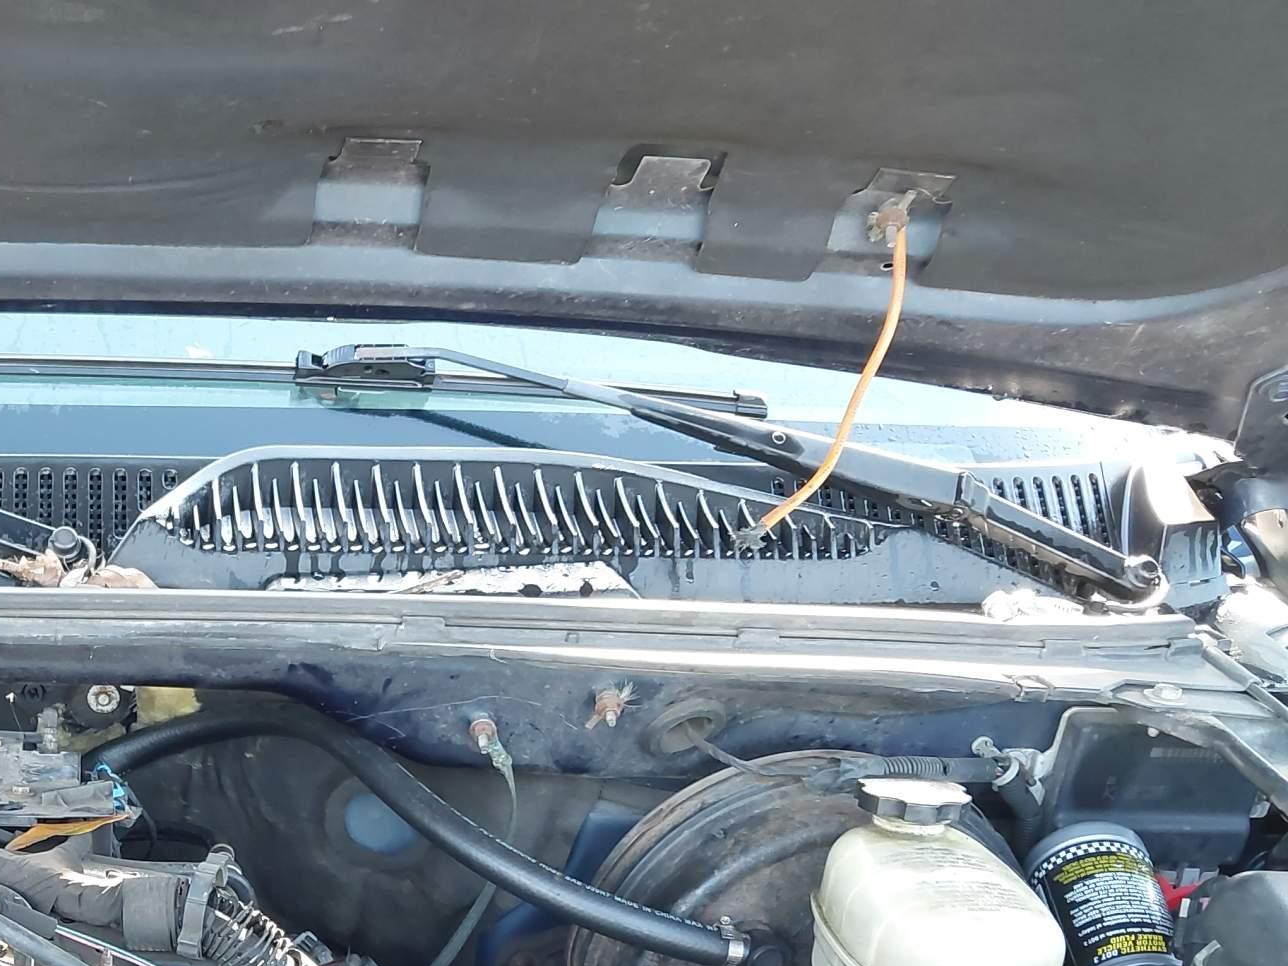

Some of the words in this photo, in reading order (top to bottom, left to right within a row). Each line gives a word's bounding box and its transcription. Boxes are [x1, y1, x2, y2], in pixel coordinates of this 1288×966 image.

[1110, 934, 1136, 944] FLUID
[1097, 940, 1135, 956] VEHICLE
[1120, 945, 1168, 955] SYNTHETIC
[1093, 956, 1100, 964] 3
[1101, 949, 1119, 961] DOT
